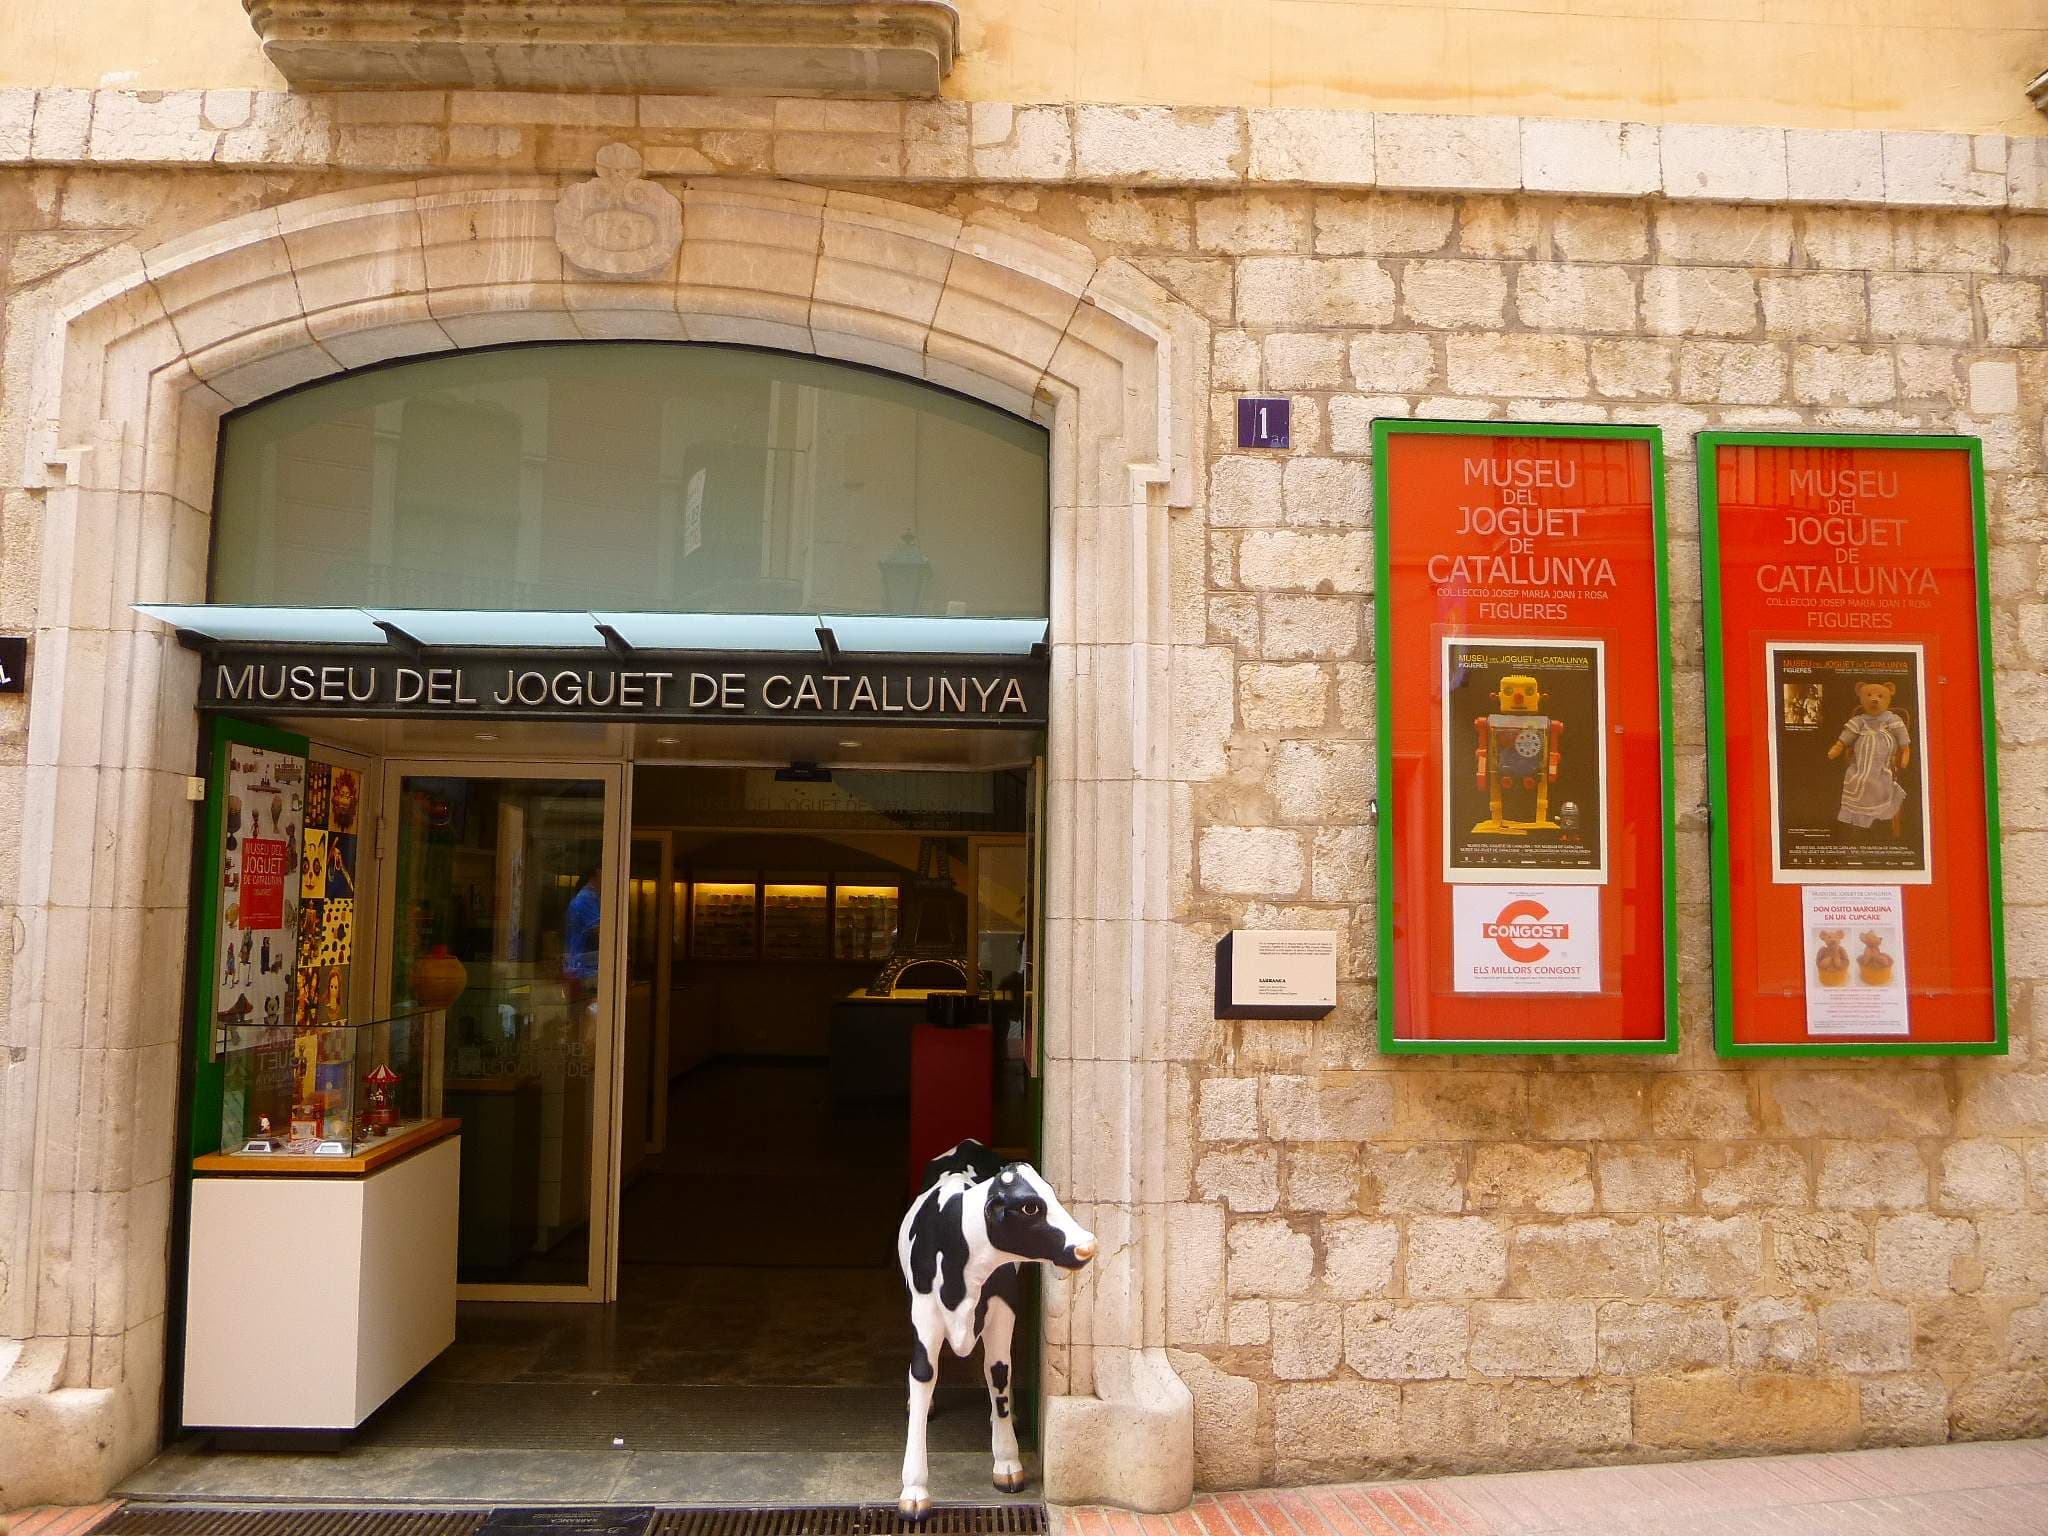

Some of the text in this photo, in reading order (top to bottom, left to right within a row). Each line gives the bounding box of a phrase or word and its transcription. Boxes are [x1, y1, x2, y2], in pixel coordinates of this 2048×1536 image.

[1259, 407, 1268, 439] 1
[1464, 458, 1575, 489] MUSEU
[1790, 469, 1898, 498] MUSEU
[1503, 488, 1538, 506] DEL
[1828, 499, 1862, 516] DEL
[1456, 506, 1586, 537] JOGUET
[1784, 517, 1908, 547] JOGUET
[1509, 538, 1534, 555] DE
[1836, 548, 1860, 564] DE
[1427, 555, 1616, 586] CATALUNYA
[1756, 564, 1940, 595] CATALUNYA
[1491, 588, 1518, 598] JOSEP
[1521, 589, 1550, 599] MARIA
[1584, 590, 1609, 600] ROSA
[1479, 603, 1568, 620] FIGUERES
[1807, 611, 1893, 629] FIGUERES
[1458, 654, 1488, 663] MUSEU
[1500, 655, 1533, 664] JOGUET
[1542, 656, 1589, 665] CATALUNYA
[216, 664, 1028, 713] MUSEU DEL JOGUET DE CATALUNYA
[244, 855, 283, 874] JOGUET
[1488, 925, 1564, 938] CONGOST
[1473, 966, 1582, 975] ELS MILLORS CONGOST
